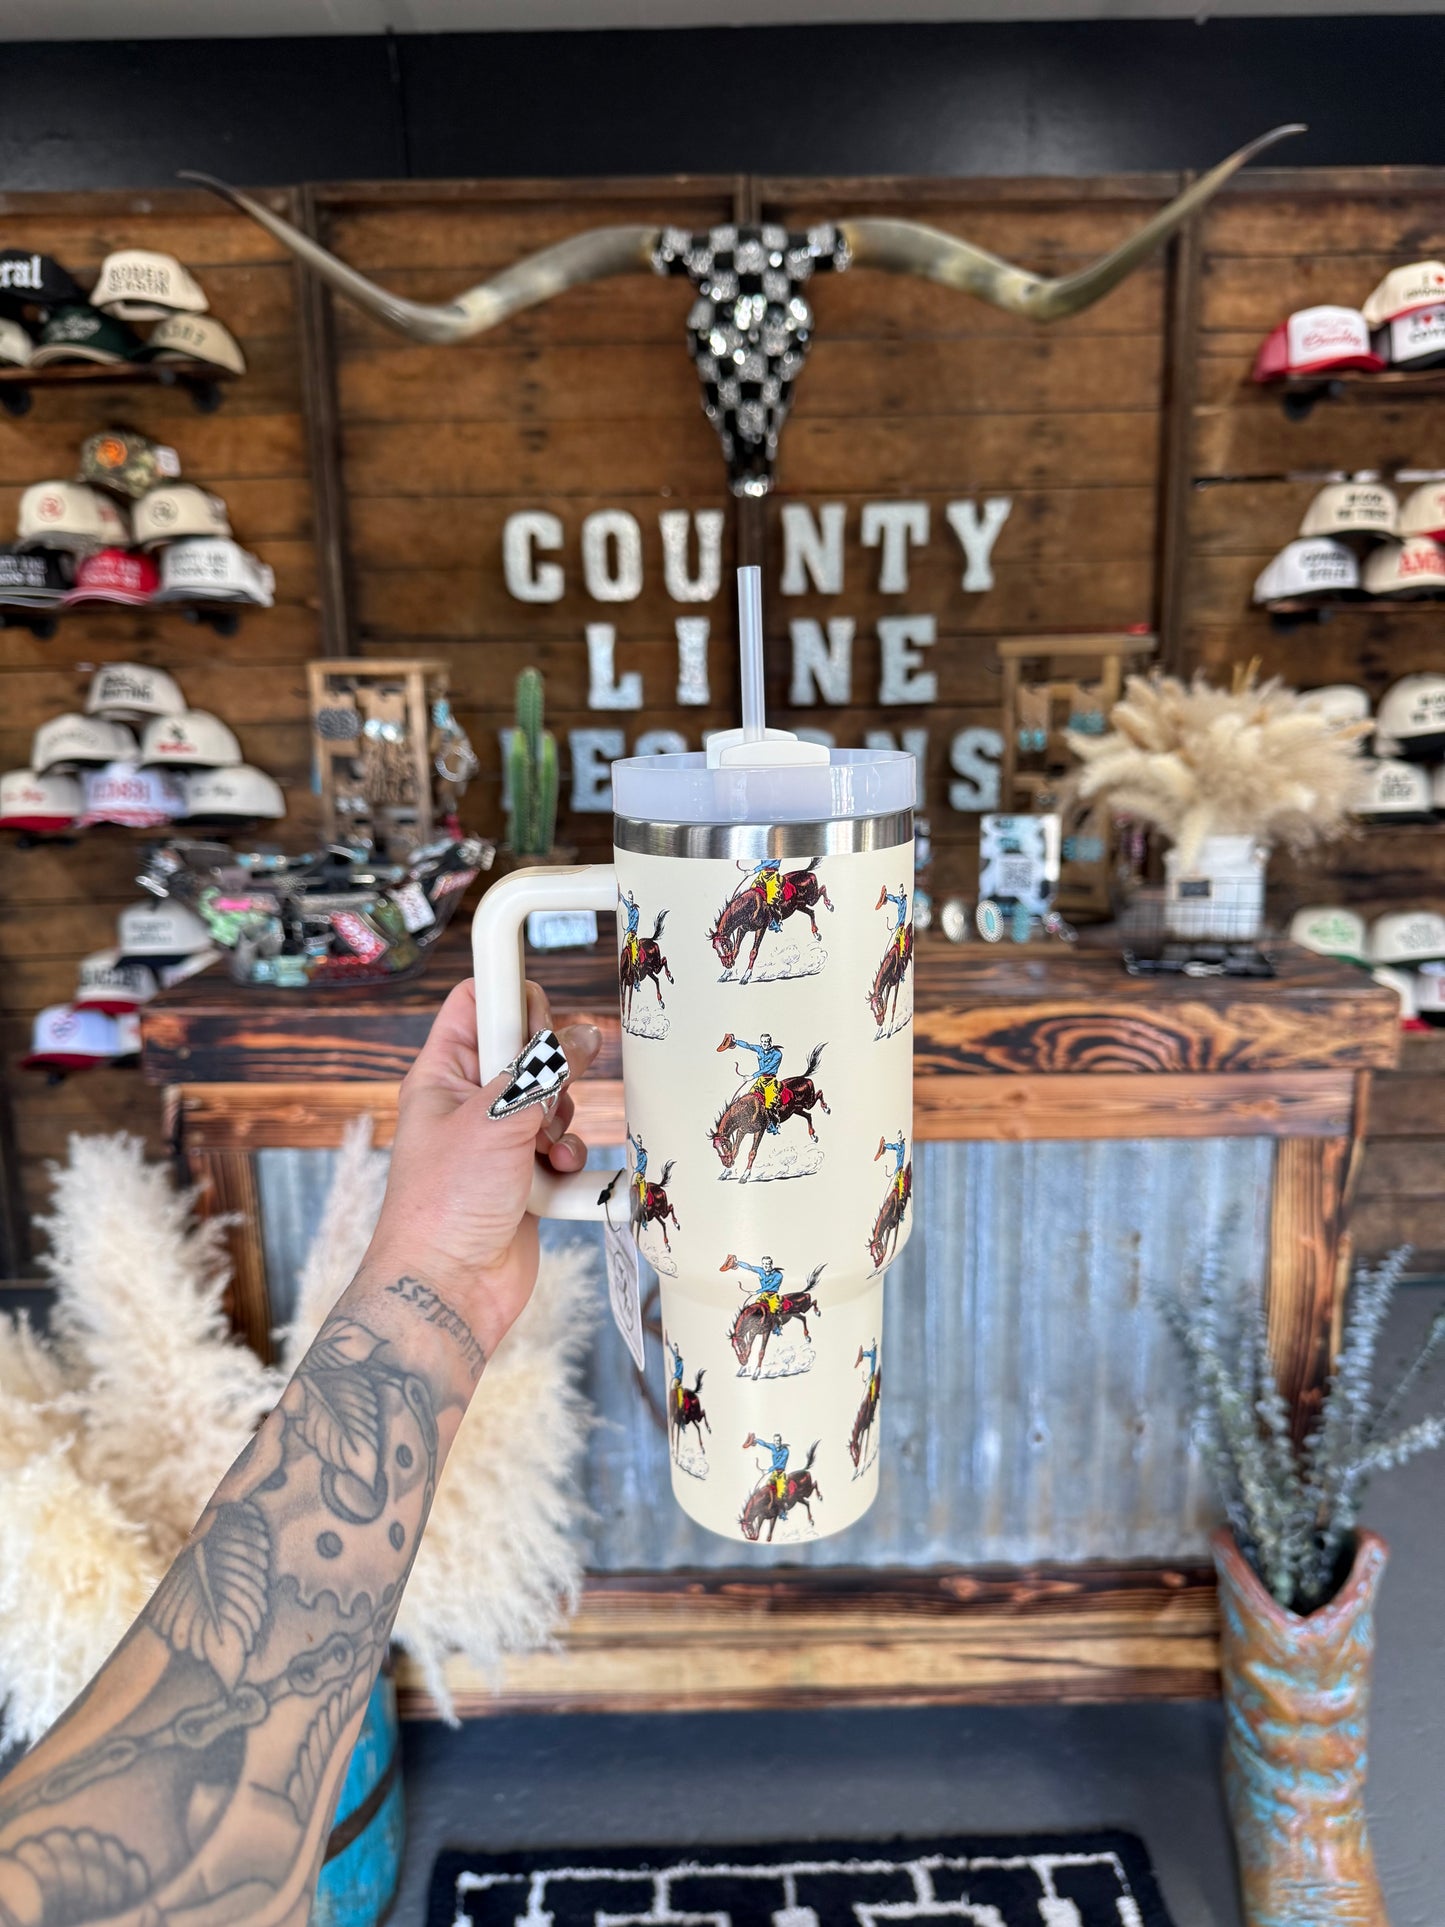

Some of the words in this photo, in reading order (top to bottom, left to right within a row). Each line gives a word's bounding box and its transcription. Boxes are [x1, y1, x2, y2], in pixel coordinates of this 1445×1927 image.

[0, 254, 43, 289] ral
[504, 500, 1012, 602] COUNTY
[587, 616, 937, 710] LINE
